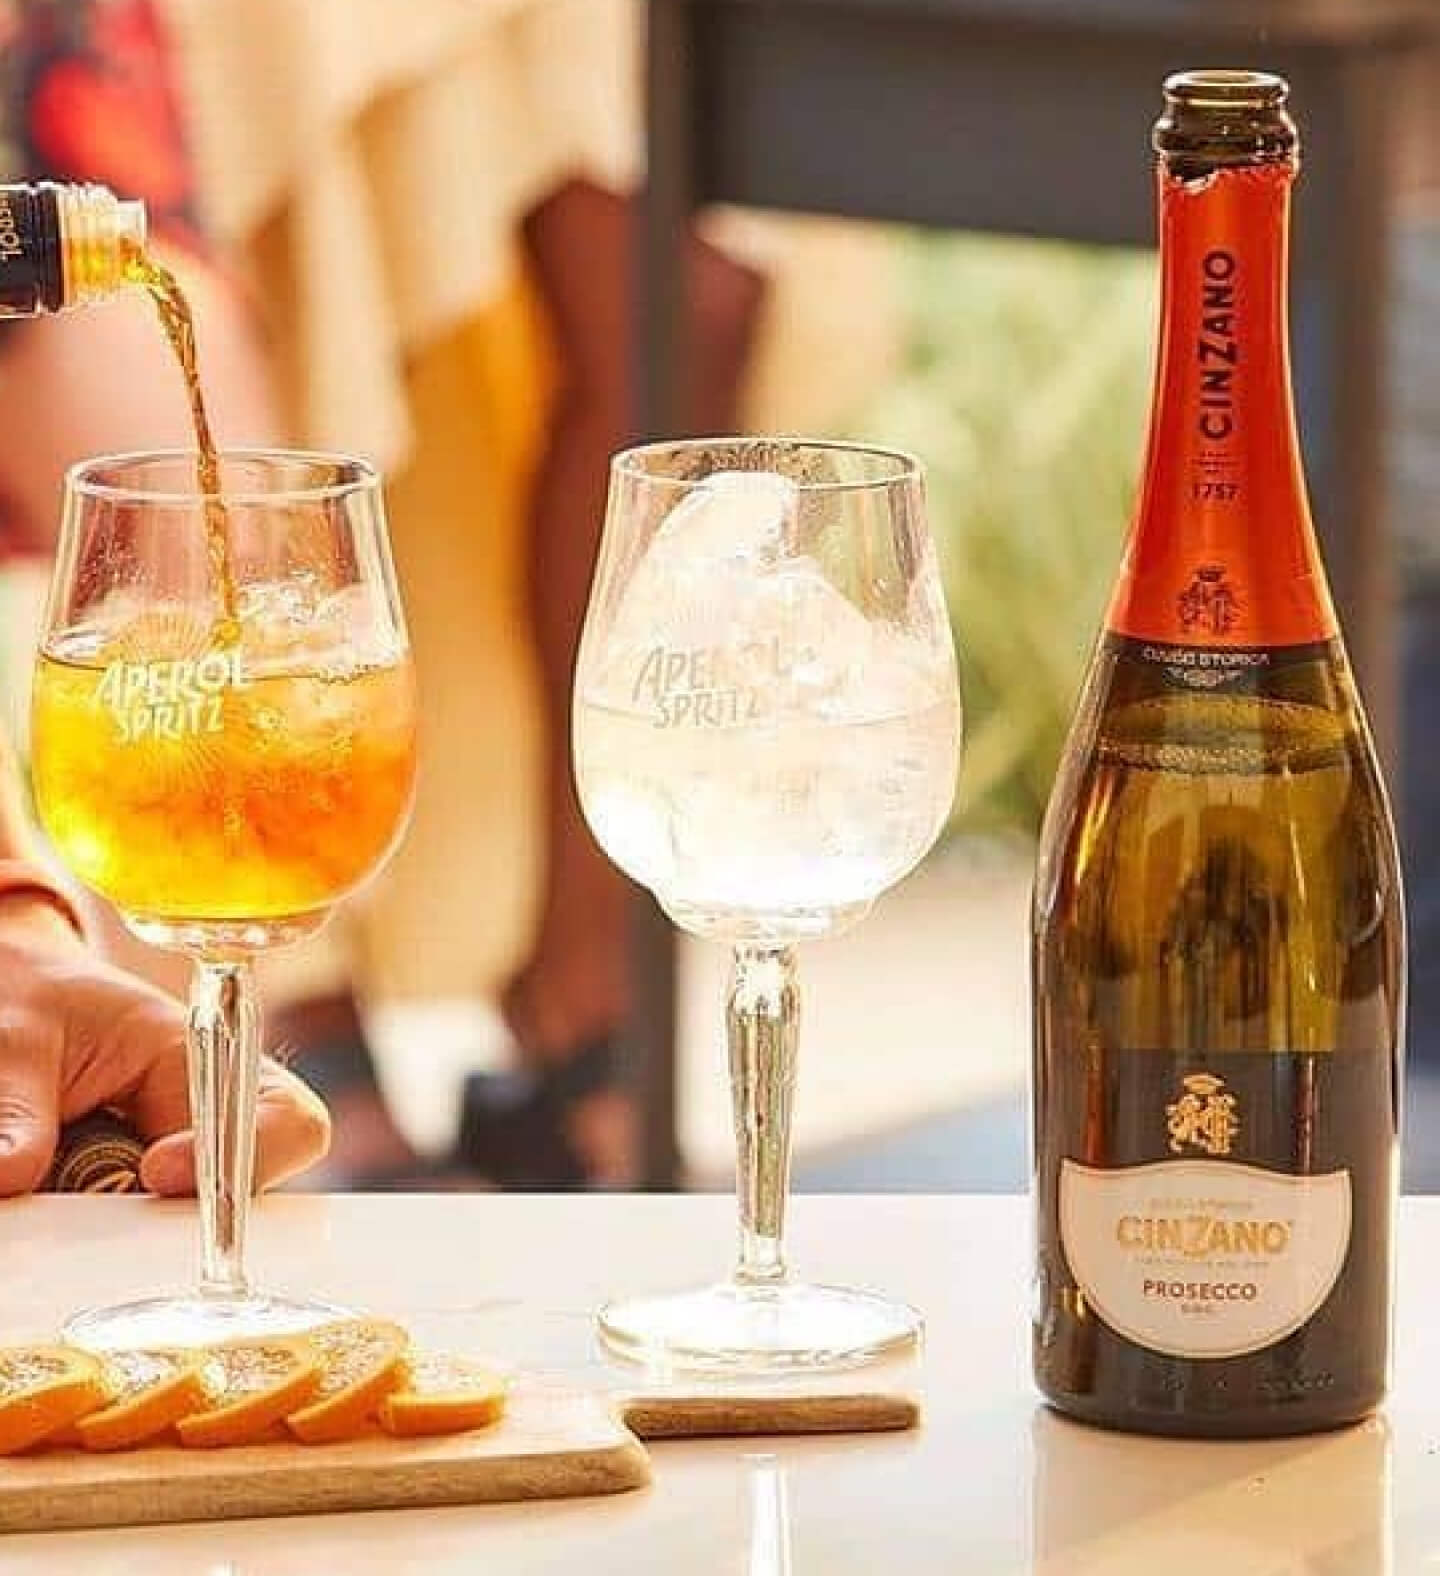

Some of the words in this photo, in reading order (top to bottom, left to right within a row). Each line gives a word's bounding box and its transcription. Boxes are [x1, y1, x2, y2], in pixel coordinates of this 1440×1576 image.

[1198, 250, 1237, 439] CINZANO
[1194, 482, 1238, 501] 1757
[95, 646, 252, 708] APEROL
[118, 697, 225, 744] SPRITZ
[1116, 1216, 1290, 1260] CINZANO
[1142, 1279, 1258, 1301] PROSECCO
